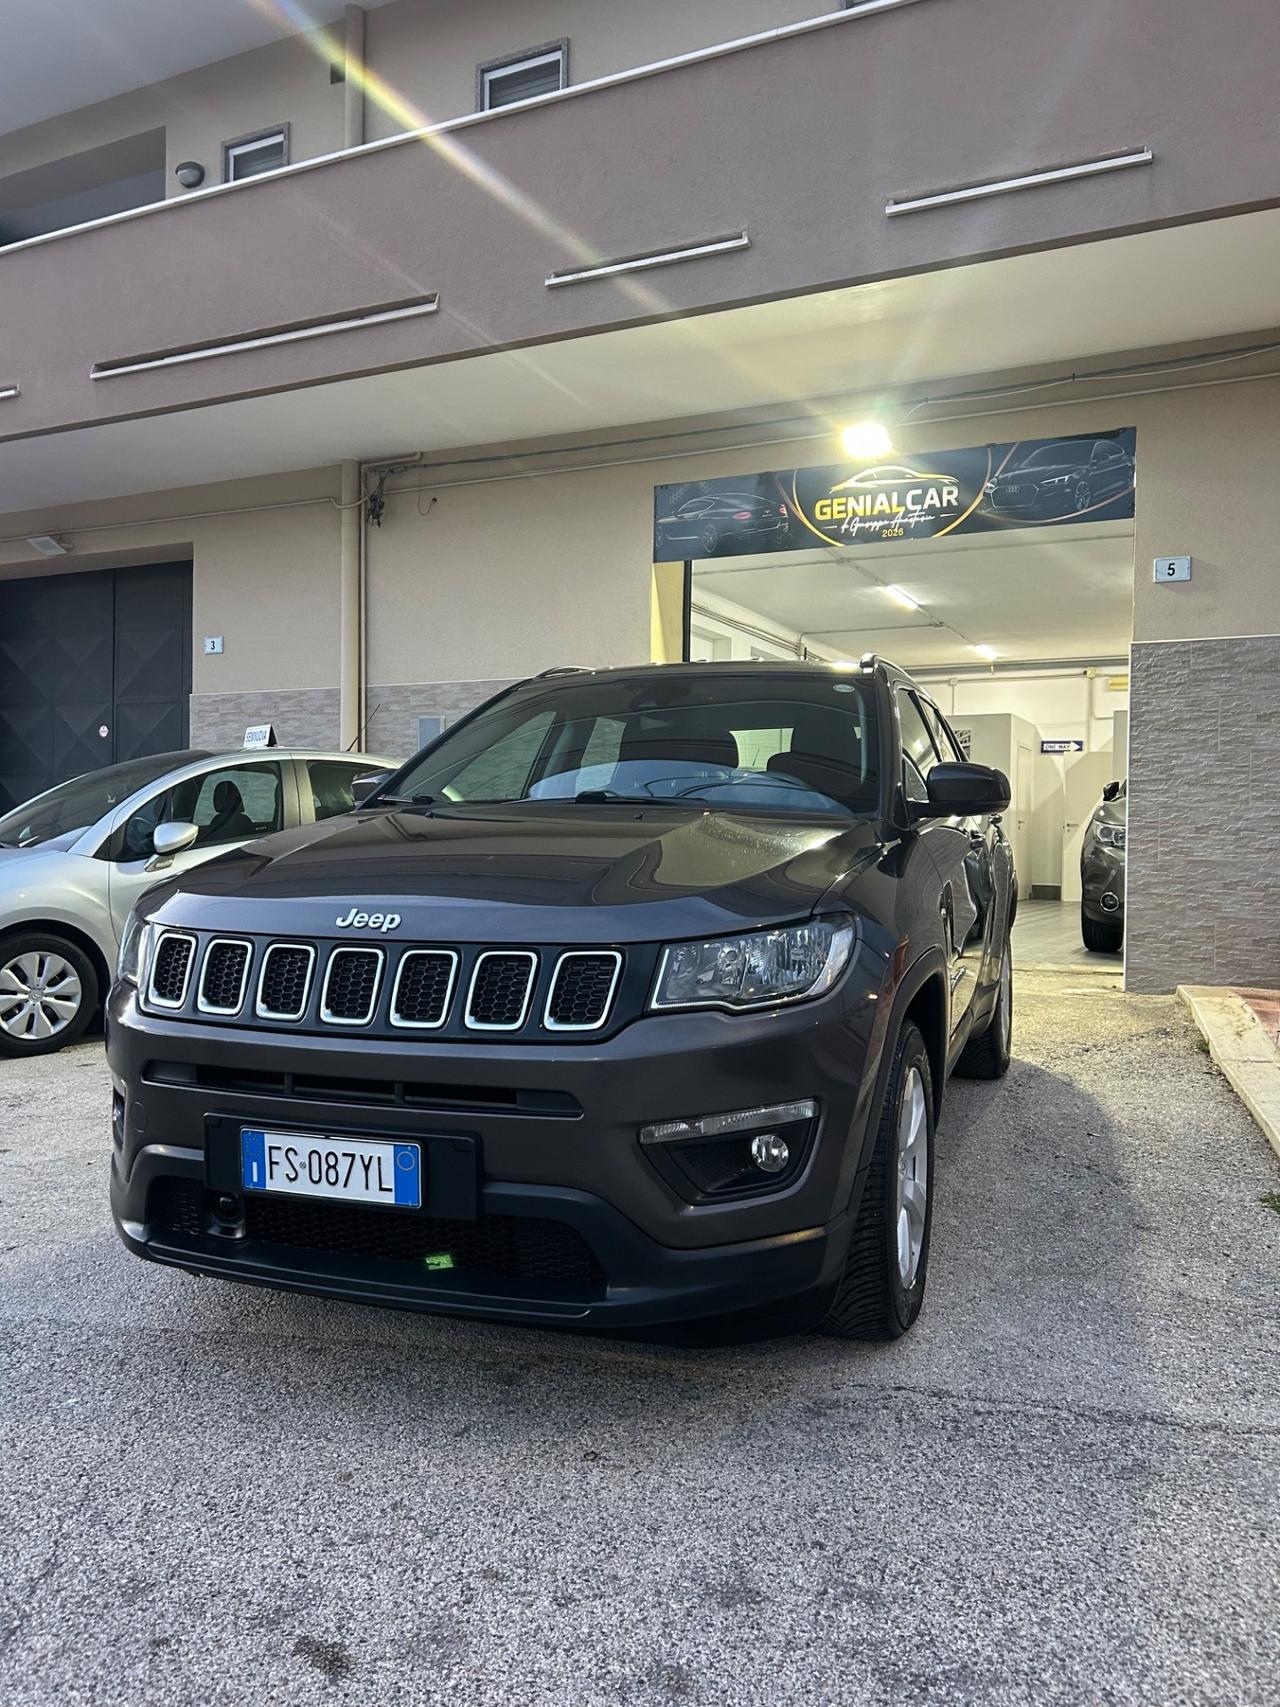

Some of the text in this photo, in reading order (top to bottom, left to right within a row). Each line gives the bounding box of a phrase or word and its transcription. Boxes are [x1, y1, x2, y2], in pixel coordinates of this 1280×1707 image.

[881, 528, 904, 538] 2026
[1167, 562, 1176, 577] 5
[210, 640, 216, 650] 3
[335, 908, 402, 933] Jeep
